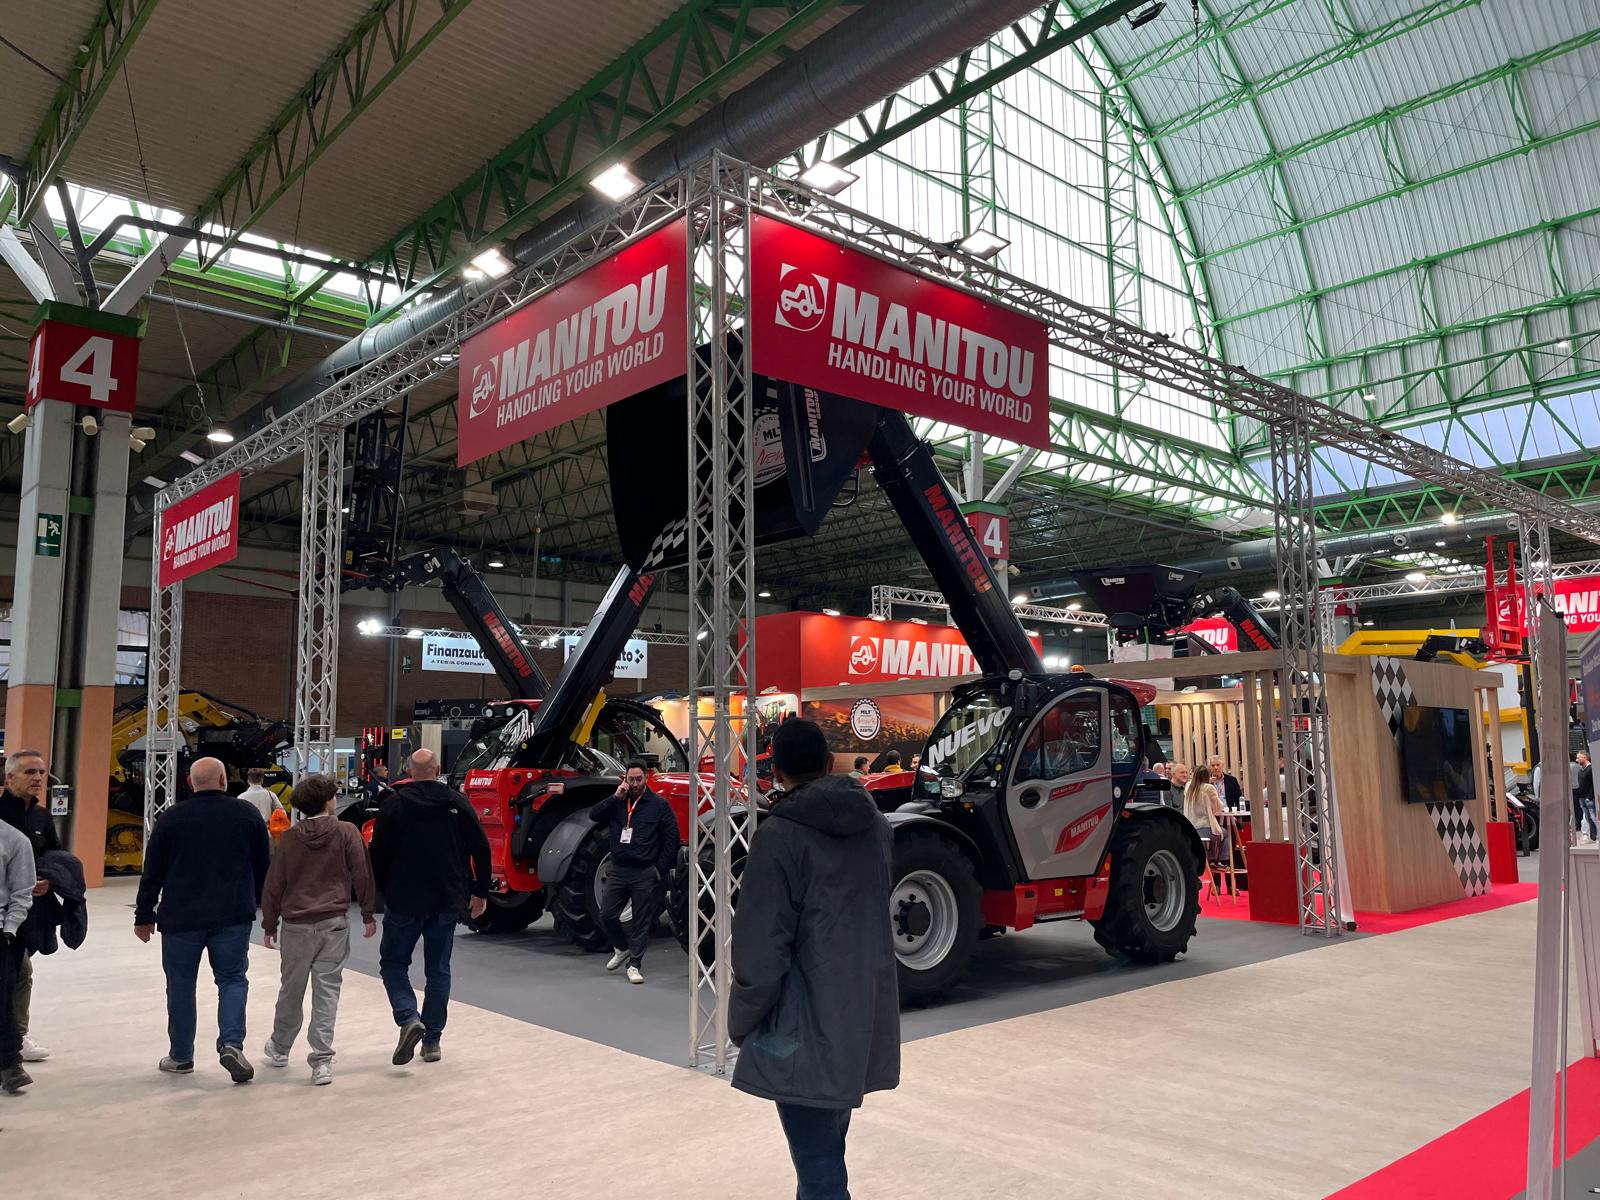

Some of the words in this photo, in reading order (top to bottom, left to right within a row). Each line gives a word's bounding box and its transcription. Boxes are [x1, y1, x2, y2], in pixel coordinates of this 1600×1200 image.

[28, 333, 42, 400] 4
[499, 264, 668, 402] MANITOU
[831, 282, 1034, 397] MANITOU
[59, 335, 118, 402] 4
[496, 379, 561, 428] HANDLING
[566, 359, 604, 397] YOUR
[607, 331, 664, 379] WORLD
[828, 342, 926, 392] HANDLING
[931, 373, 976, 407] YOUR
[979, 388, 1032, 424] WORLD
[805, 387, 822, 451] MANITOU
[173, 547, 198, 570] HANDLING
[211, 531, 231, 553] WORLD
[175, 495, 234, 554] MANITOU
[924, 483, 993, 593] MANITOU
[983, 517, 1003, 555] 4
[482, 610, 534, 678] MANITOU
[928, 706, 1013, 769] NUEVO
[1070, 815, 1099, 839] MANITOU
